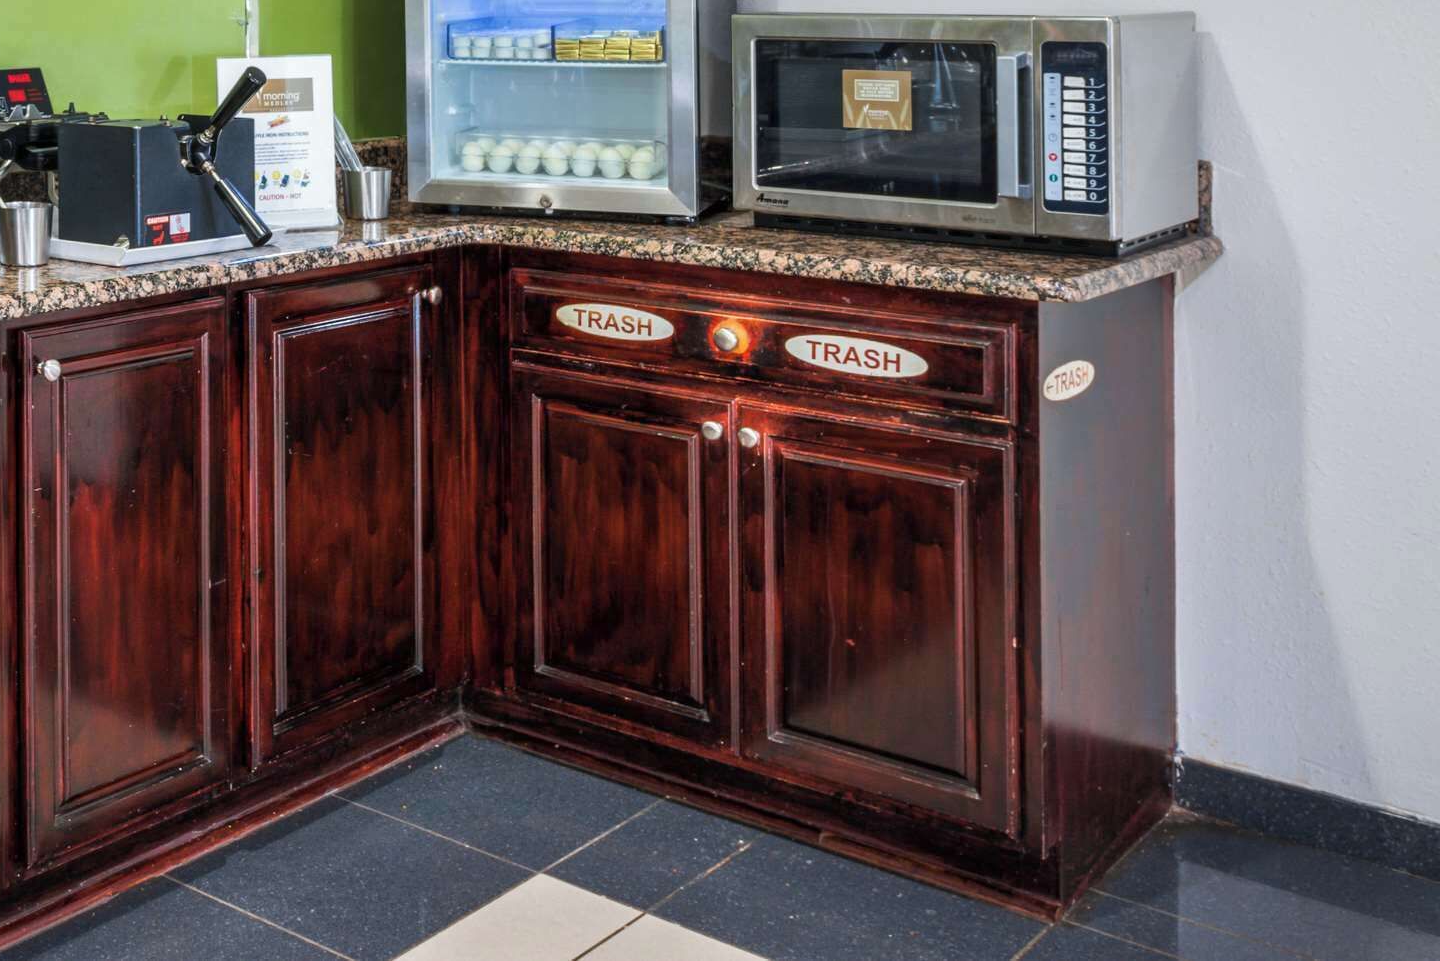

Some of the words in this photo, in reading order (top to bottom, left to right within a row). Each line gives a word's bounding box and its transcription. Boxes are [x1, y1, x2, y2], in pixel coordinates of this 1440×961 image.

[1089, 78, 1095, 87] 1
[1088, 90, 1096, 100] 2
[1088, 103, 1096, 112] 3
[1088, 116, 1096, 125] 4
[1089, 128, 1096, 137] 5
[1089, 141, 1096, 150] 6
[1089, 154, 1096, 163] 7
[1089, 167, 1097, 175] 8
[1089, 179, 1097, 188] 9
[258, 193, 285, 201] CAUTION
[756, 192, 789, 205] Amana
[1089, 192, 1097, 201] 0
[572, 307, 653, 337] TRASH
[805, 339, 902, 374] TRASH
[1054, 365, 1089, 395] TRASH
